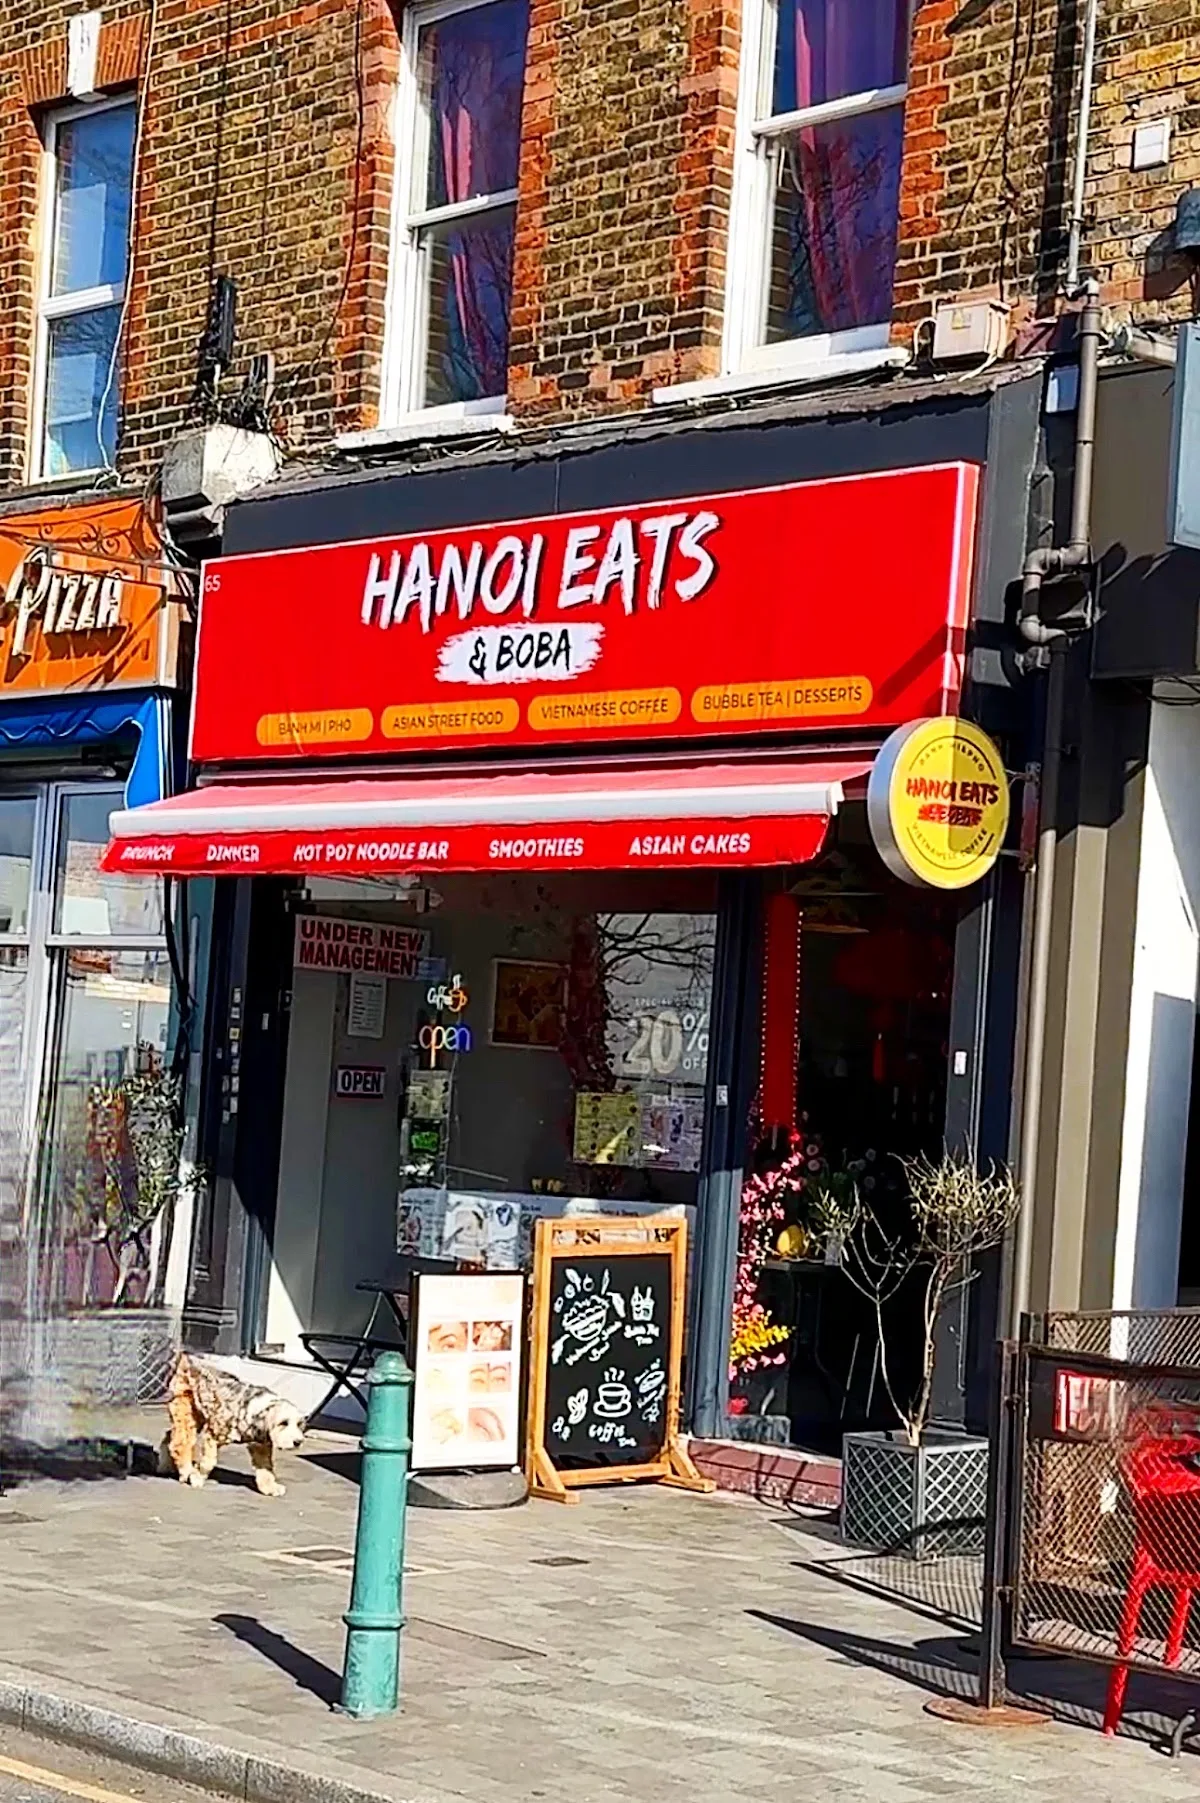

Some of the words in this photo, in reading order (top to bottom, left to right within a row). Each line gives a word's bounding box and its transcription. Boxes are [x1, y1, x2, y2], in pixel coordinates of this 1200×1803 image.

[204, 575, 221, 592] 65
[361, 533, 544, 634] HANOI
[557, 511, 720, 616] EATS
[496, 628, 572, 672] BOBA
[541, 700, 616, 720] VIETNAMESE
[619, 697, 669, 715] COFFEE
[703, 692, 755, 710] BUBBLE
[758, 690, 784, 707] TEA
[793, 685, 863, 706] DESSERTS
[328, 718, 352, 732] PHO
[393, 715, 425, 730] ASIAN
[427, 712, 468, 728] STREET
[470, 710, 504, 726] FOOD
[906, 777, 957, 802] HANOI
[959, 780, 1000, 805] EATS
[206, 844, 260, 862] DINNER
[293, 844, 324, 862] HOT
[325, 843, 353, 861] POT
[356, 841, 415, 861] NOODLE
[417, 841, 450, 859] BAR
[488, 838, 584, 858] SMOOTHIES
[628, 835, 687, 856] ASIAN
[690, 833, 751, 855] CAKES
[300, 919, 373, 947] UNDER
[419, 1025, 471, 1068] open
[341, 1070, 382, 1094] OPEN
